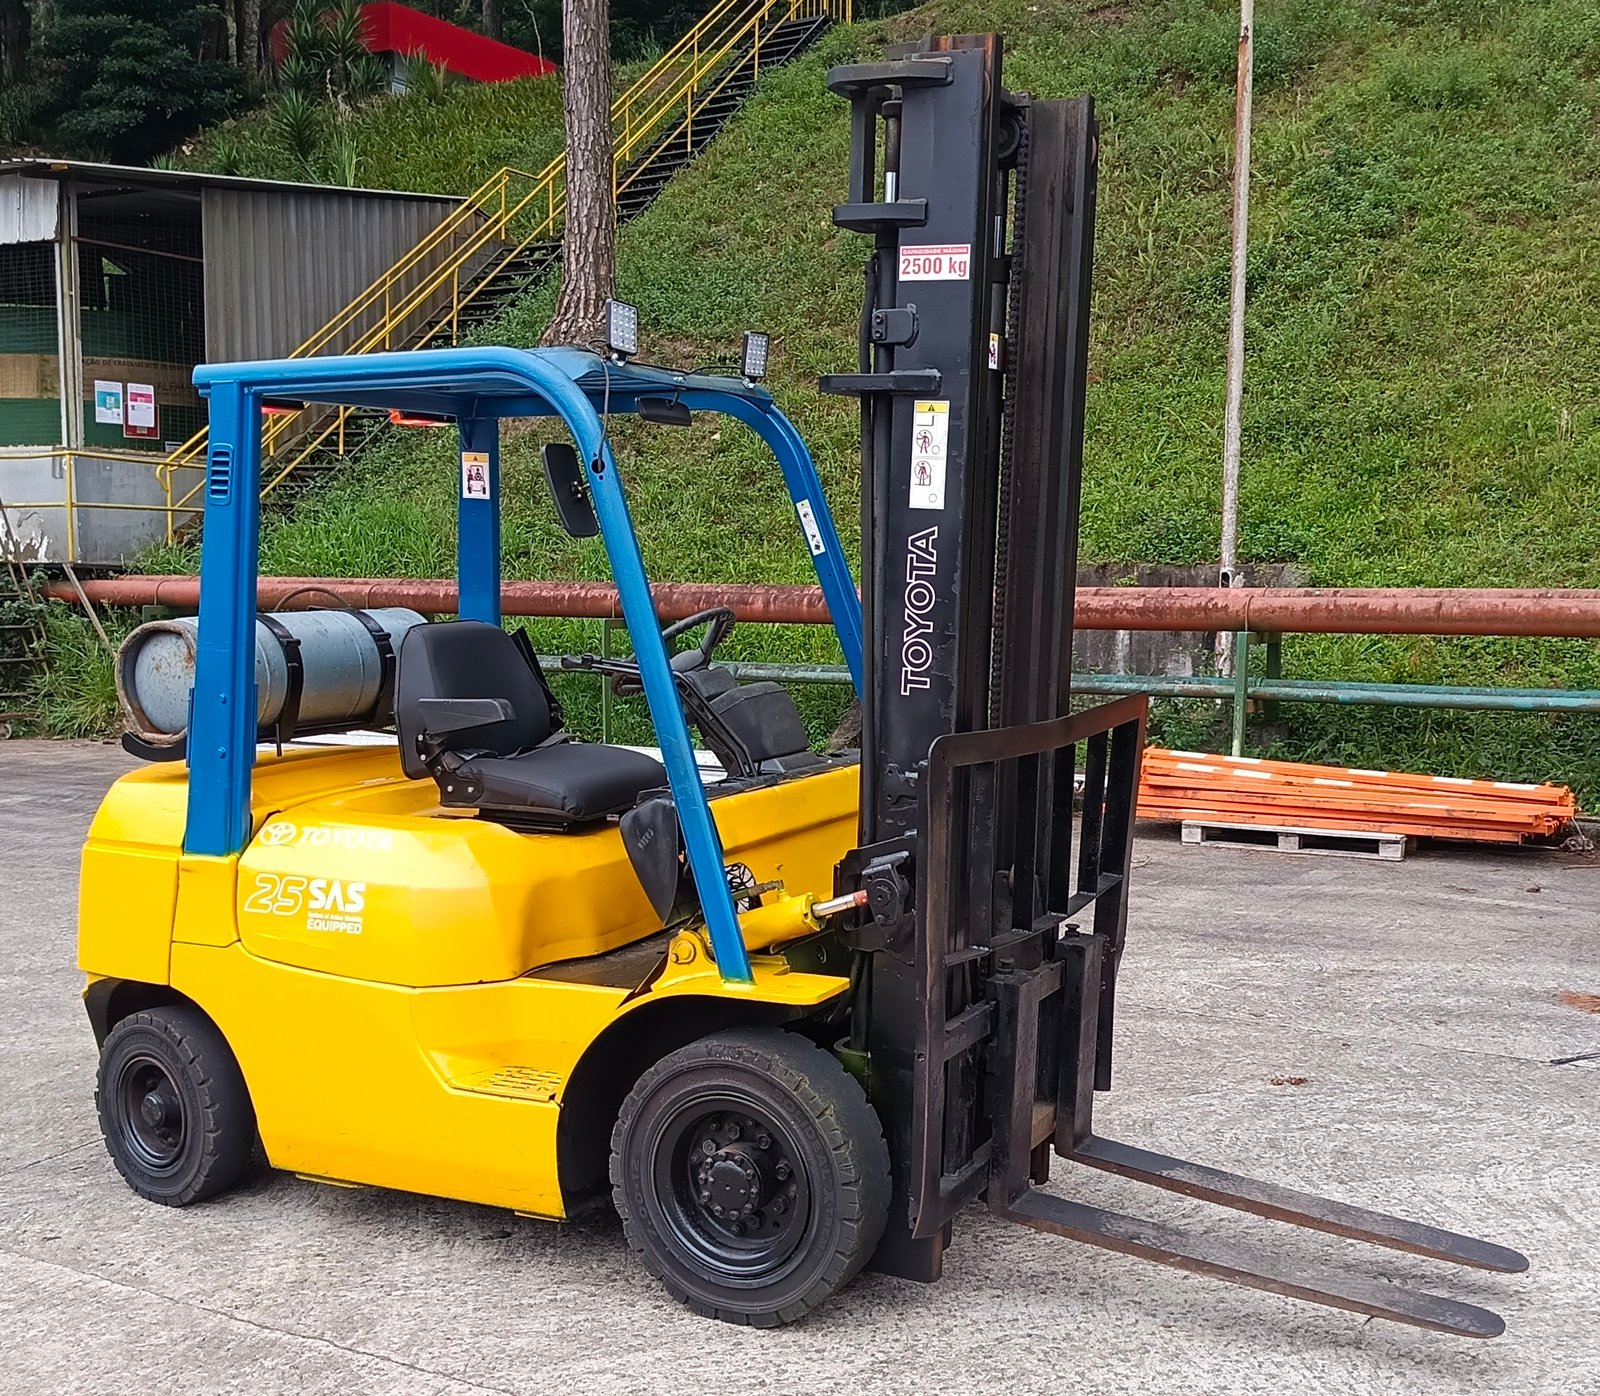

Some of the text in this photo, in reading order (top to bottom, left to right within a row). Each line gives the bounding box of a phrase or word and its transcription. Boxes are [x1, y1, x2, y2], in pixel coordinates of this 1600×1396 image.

[902, 246, 968, 256] CAPACIDADE MÁXIMA
[902, 257, 967, 277] 2500 kg
[900, 525, 938, 696] TOYOTA
[298, 827, 393, 852] TOYOTA
[243, 872, 308, 917] 25
[306, 919, 363, 935] EQUIPPED
